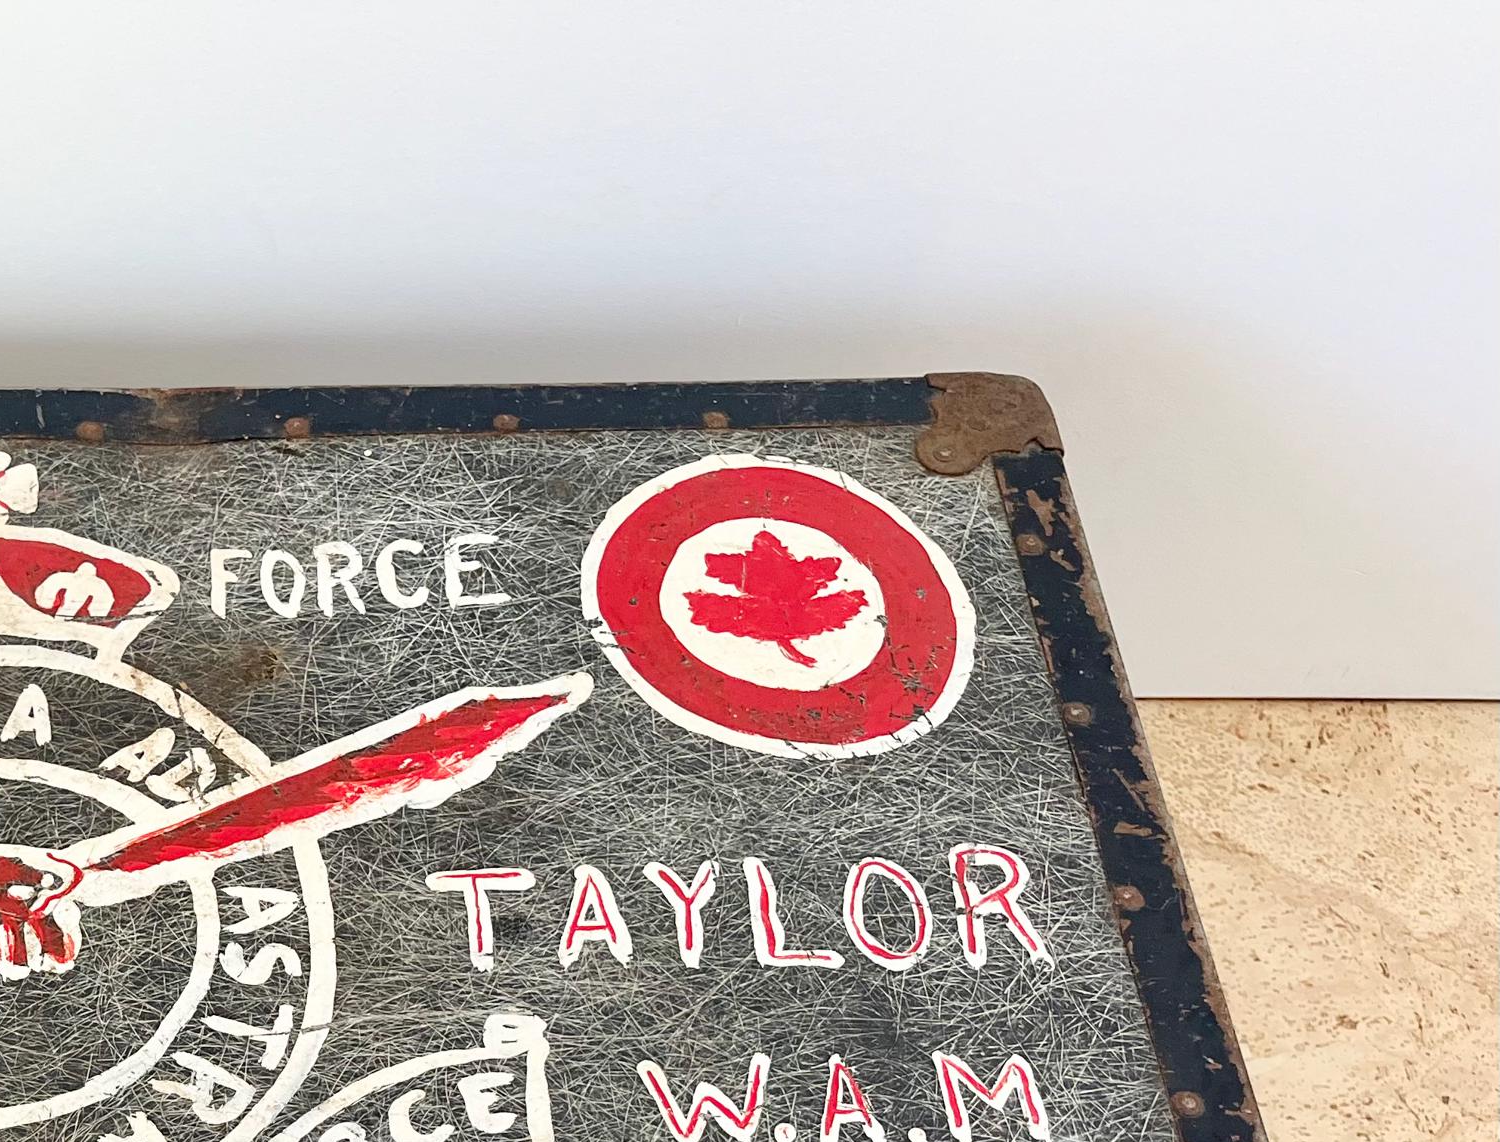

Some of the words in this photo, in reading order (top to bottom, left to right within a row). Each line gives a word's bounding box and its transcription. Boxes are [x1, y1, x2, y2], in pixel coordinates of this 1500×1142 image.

[209, 532, 512, 620] FORCE
[103, 726, 221, 808] AD
[425, 842, 1056, 973] TAYLOR
